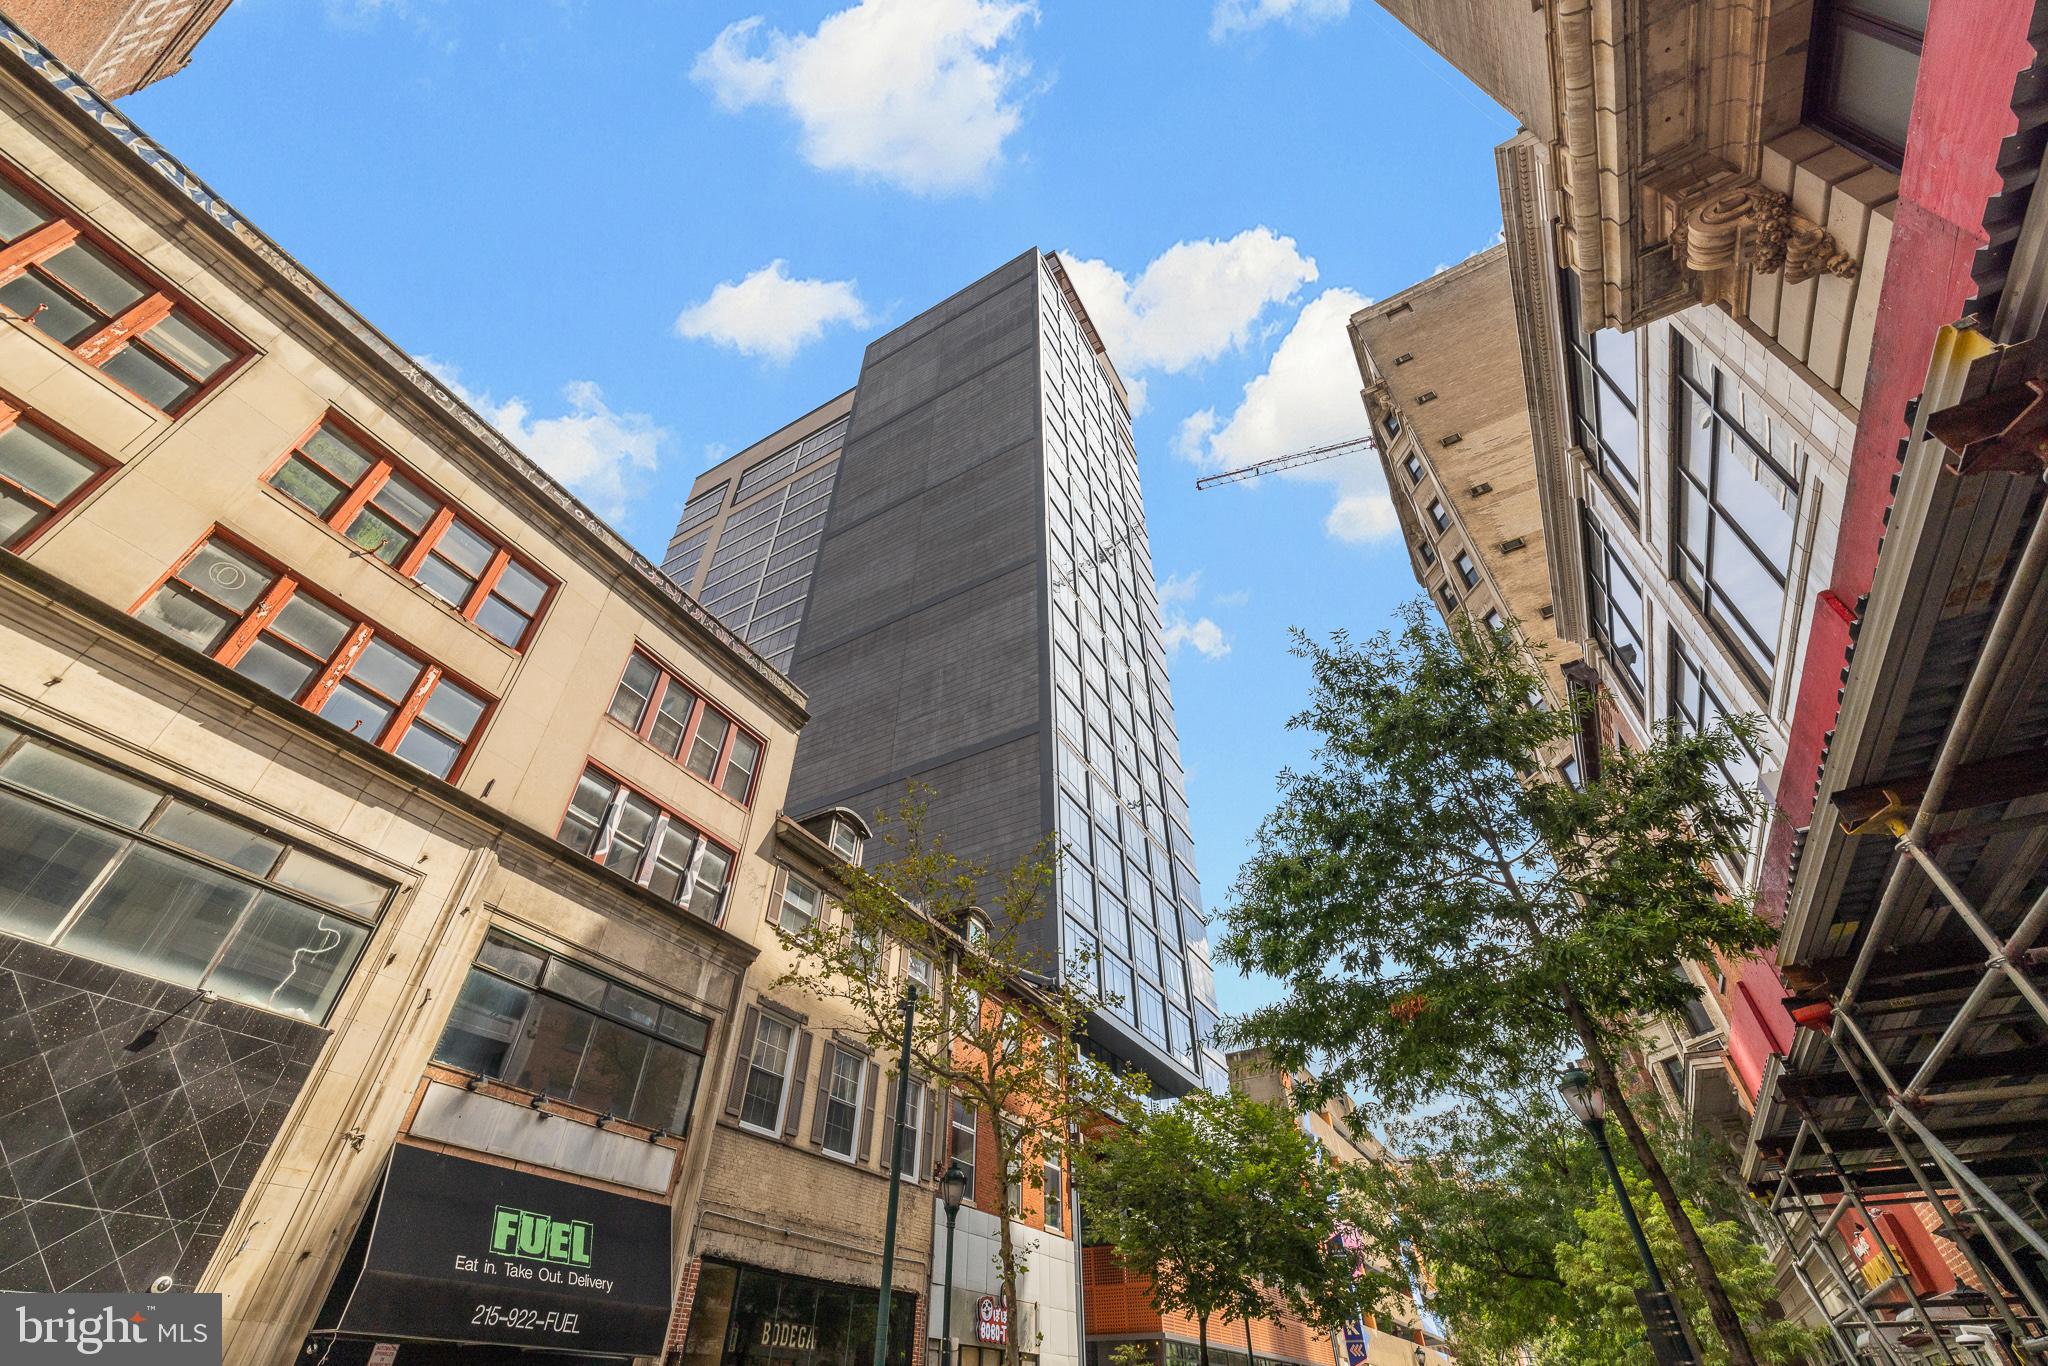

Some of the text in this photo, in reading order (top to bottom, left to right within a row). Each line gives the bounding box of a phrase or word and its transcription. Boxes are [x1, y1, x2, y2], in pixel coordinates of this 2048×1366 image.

[493, 1209, 591, 1265] FUEL
[455, 1254, 614, 1295] Eat in. Take Out. Delivery
[471, 1304, 581, 1335] 215-922-FUEL
[761, 1321, 816, 1350] BODEGA
